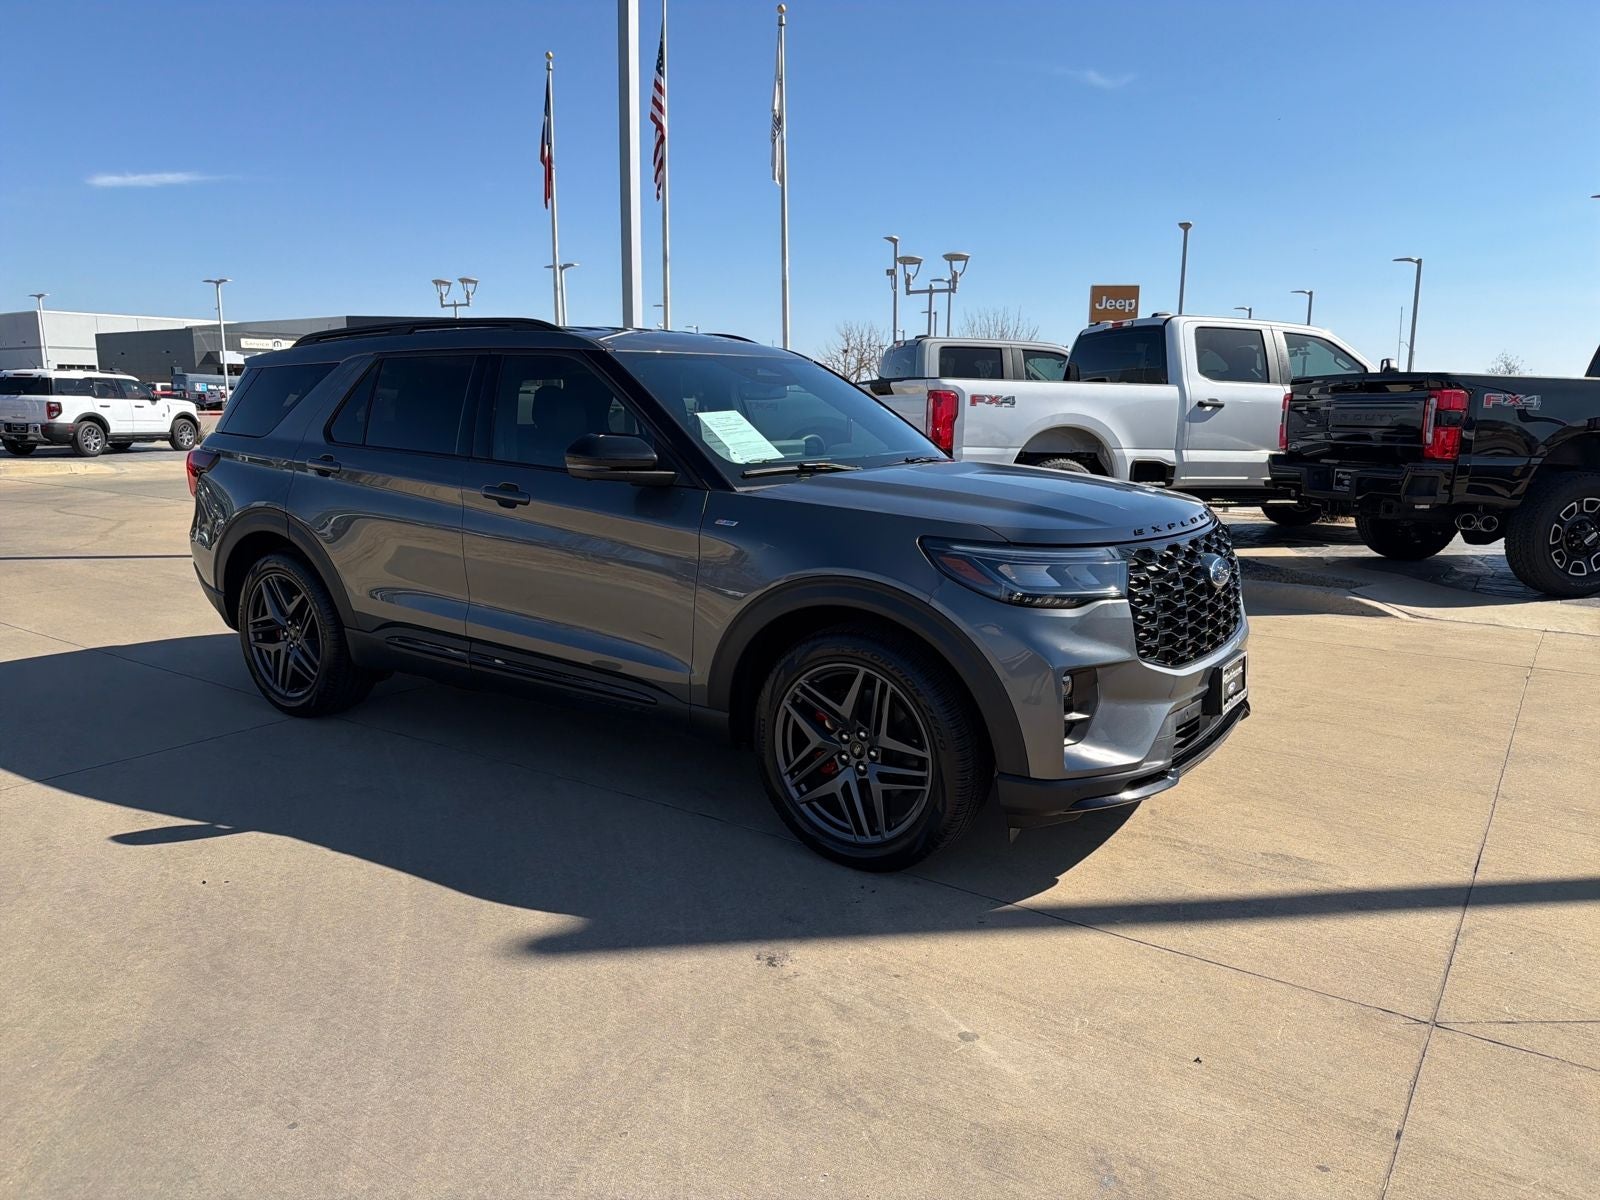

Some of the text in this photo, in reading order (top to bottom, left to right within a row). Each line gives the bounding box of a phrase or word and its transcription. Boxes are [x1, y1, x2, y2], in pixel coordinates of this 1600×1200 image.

[1095, 296, 1136, 313] Jeep
[970, 394, 1016, 406] FX4
[1482, 393, 1540, 408] FX4
[1133, 507, 1211, 537] EXPLORE
